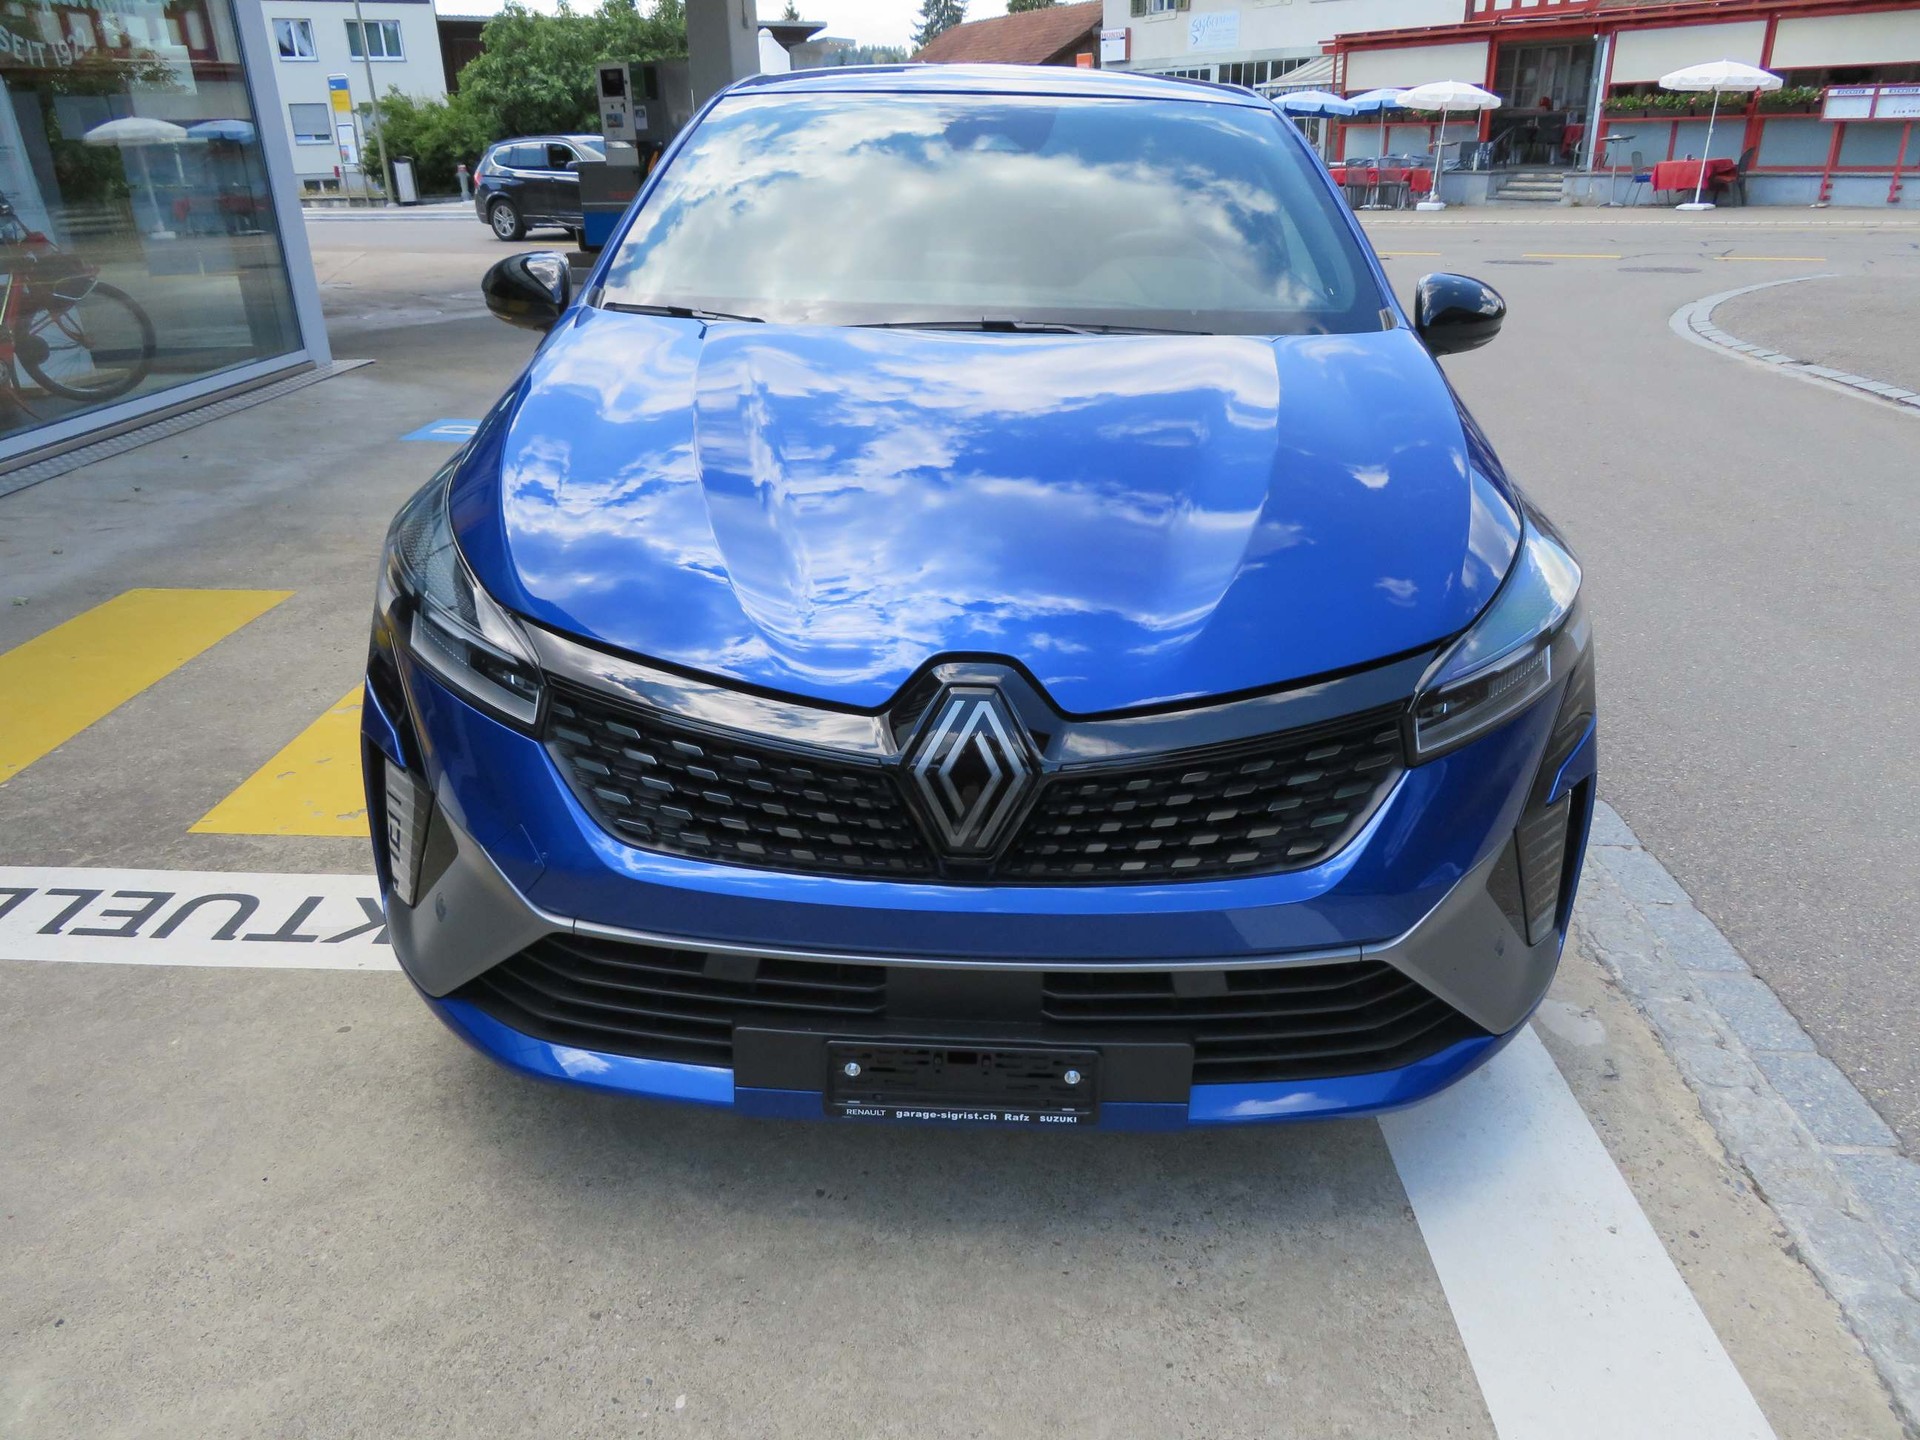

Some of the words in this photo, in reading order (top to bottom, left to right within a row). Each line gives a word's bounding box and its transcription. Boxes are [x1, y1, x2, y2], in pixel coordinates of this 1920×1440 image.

[0, 25, 47, 69] SEIT
[846, 1108, 886, 1117] RENAULT
[896, 1109, 997, 1121] garage-sigrist.ch
[1004, 1112, 1030, 1122] Rafz
[1040, 1115, 1077, 1123] SUZUKI
